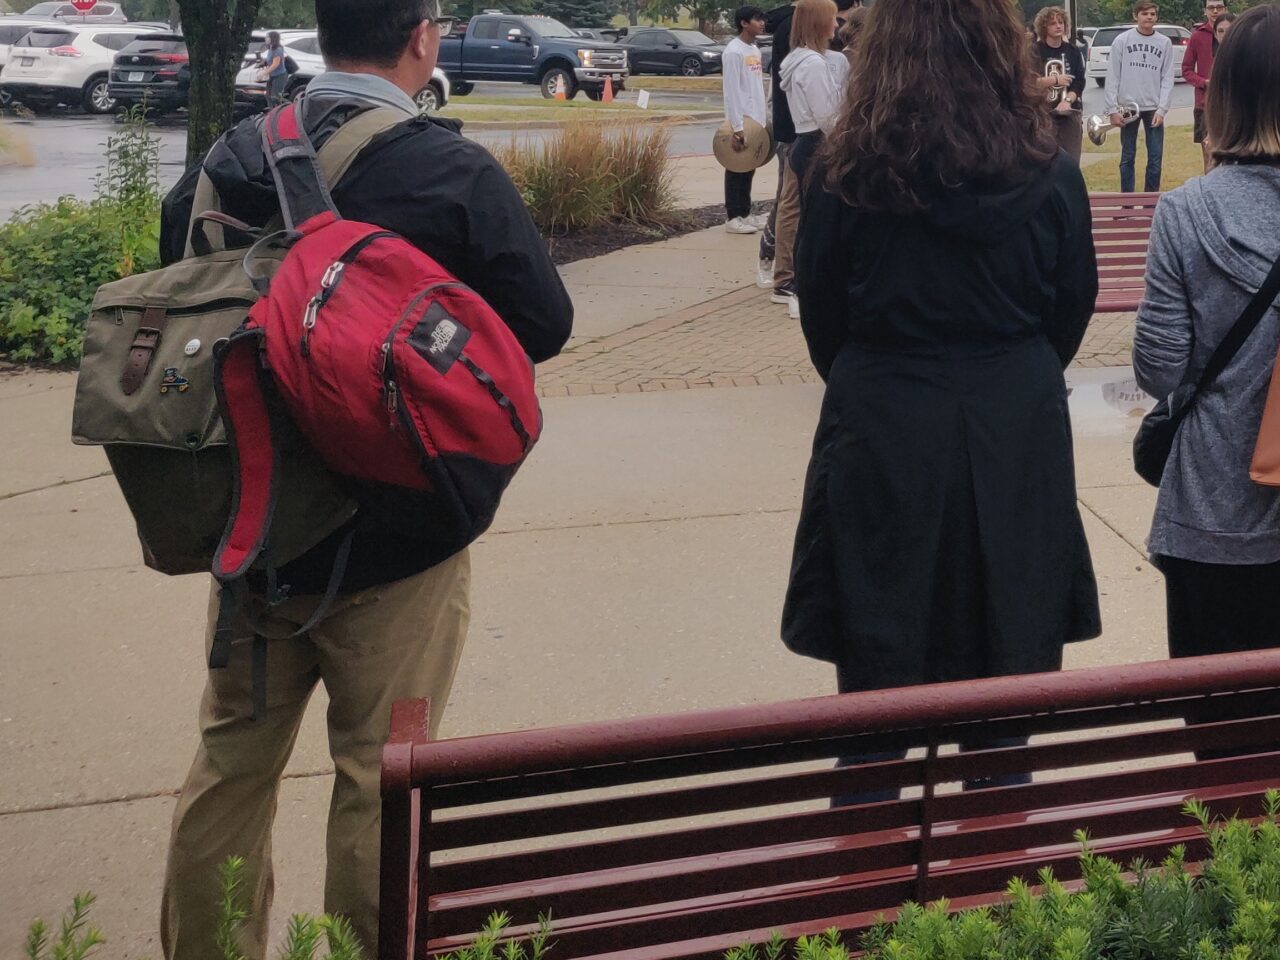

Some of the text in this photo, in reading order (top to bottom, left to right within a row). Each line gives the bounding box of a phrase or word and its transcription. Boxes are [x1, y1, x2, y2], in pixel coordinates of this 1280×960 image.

[1127, 43, 1162, 59] BATAVIA
[431, 325, 443, 339] THE
[430, 330, 447, 354] NORTH
[438, 334, 451, 353] FACE
